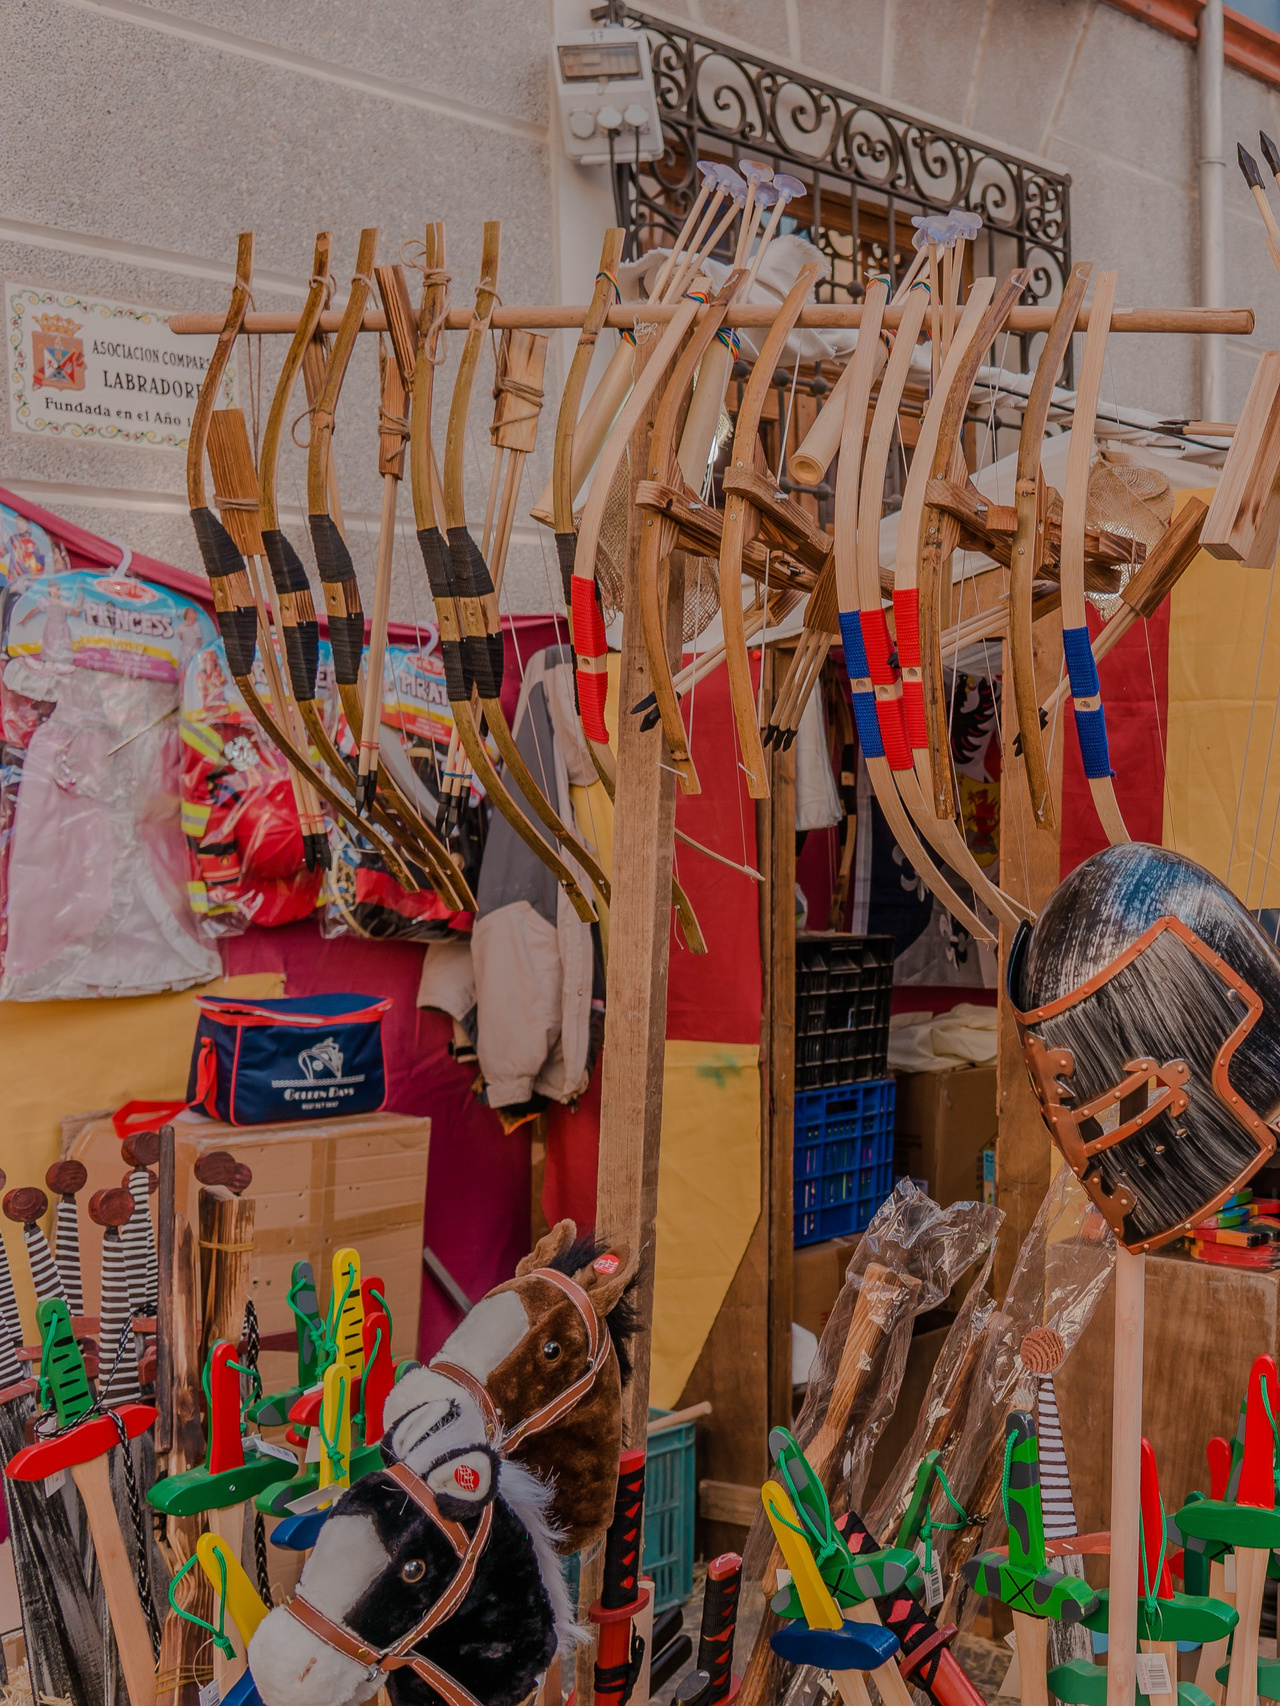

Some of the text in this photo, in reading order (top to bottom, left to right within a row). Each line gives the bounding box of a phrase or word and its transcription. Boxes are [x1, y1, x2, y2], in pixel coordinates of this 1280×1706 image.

[92, 340, 210, 371] ASOCIACION COMPARS
[45, 397, 111, 417] Fundada
[116, 409, 132, 420] en
[137, 410, 149, 422] el
[154, 412, 181, 426] Año
[84, 602, 174, 639] PRINCESS
[399, 670, 448, 706] PIRAT
